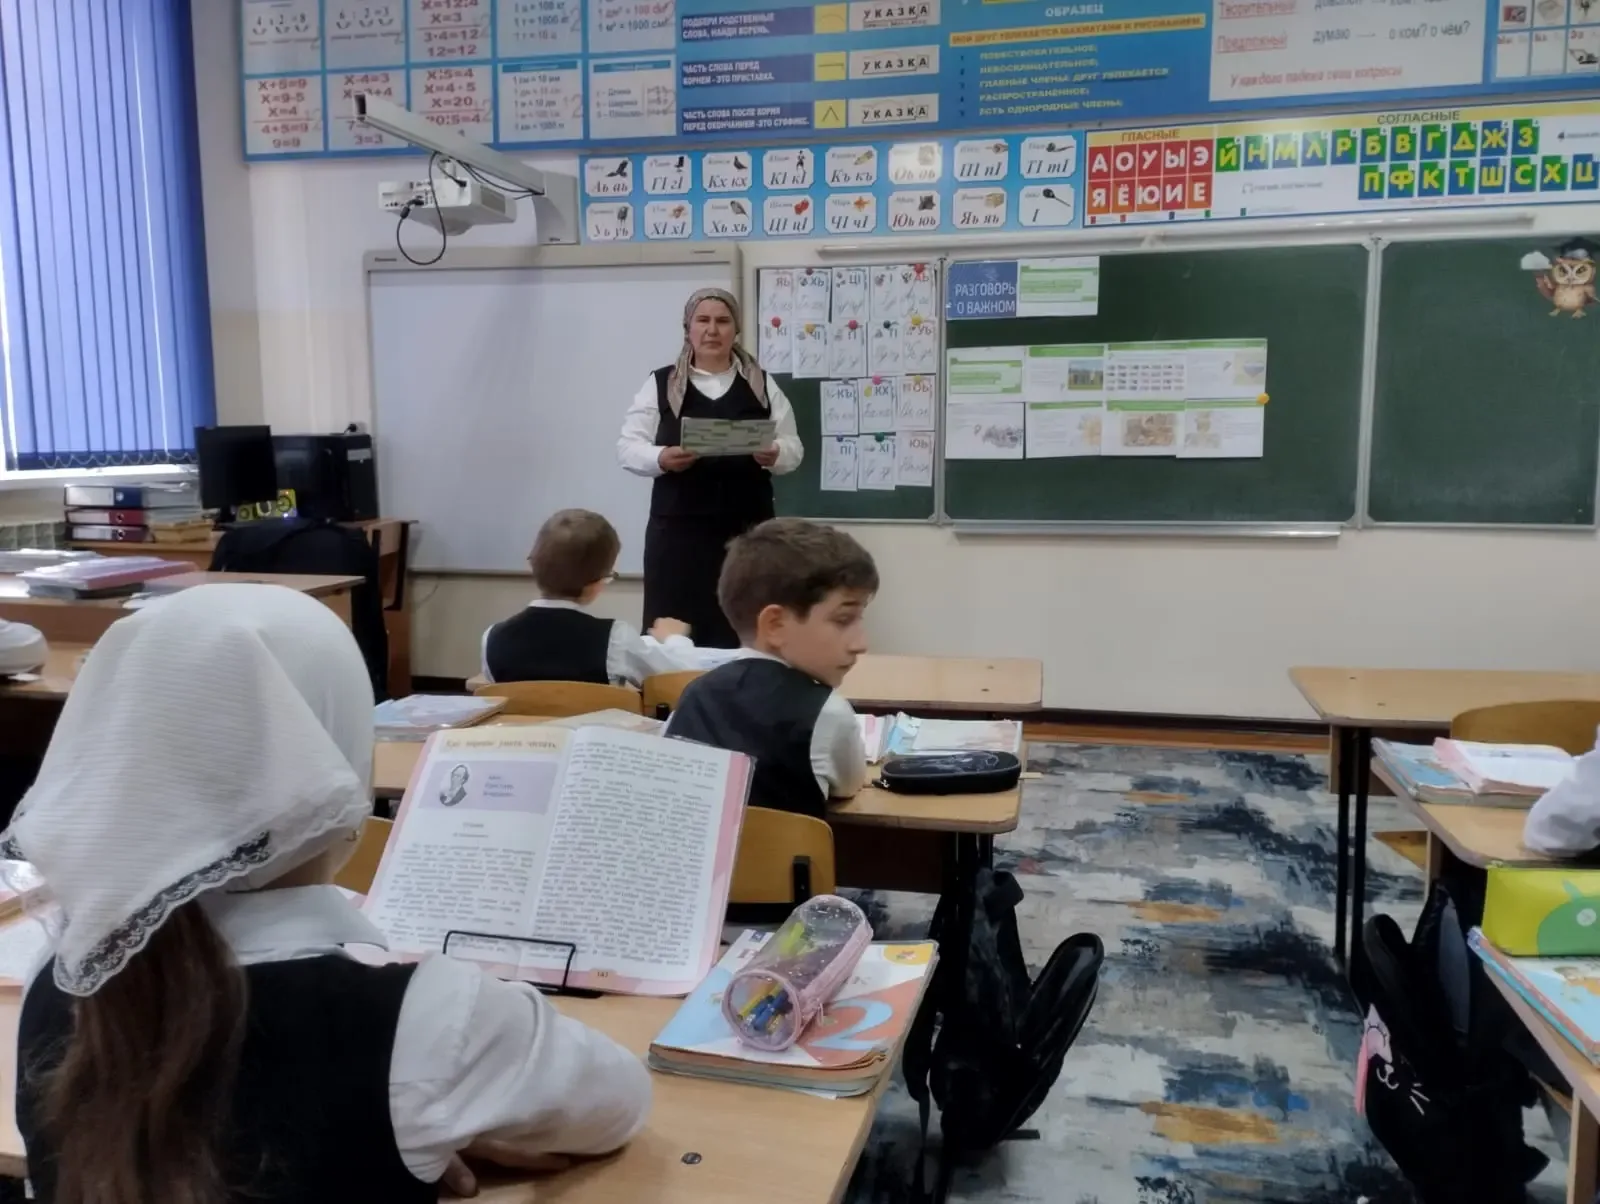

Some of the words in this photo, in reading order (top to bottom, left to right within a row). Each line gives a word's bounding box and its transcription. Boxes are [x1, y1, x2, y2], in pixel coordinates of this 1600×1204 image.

[863, 5, 928, 19] УКАЗКА
[1045, 4, 1104, 17] ОБРАЗЕЦ
[1313, 28, 1351, 45] думаю
[1398, 22, 1428, 39] ком?
[863, 57, 927, 71] УКАЗКА
[863, 106, 926, 119] УКАЗКА
[1377, 110, 1460, 125] СОГЛАСНЫЕ
[1121, 128, 1180, 143] ГЛАСНЫЕ
[1092, 154, 1108, 173] А
[1115, 151, 1134, 171] О
[1142, 149, 1157, 170] У
[1165, 148, 1185, 169] Ы
[1192, 146, 1209, 166] Э
[1363, 172, 1379, 193] П
[1389, 170, 1415, 191] Ф
[1422, 169, 1440, 190] К
[1455, 167, 1469, 188] Т
[1481, 166, 1504, 187] Ш
[1514, 164, 1532, 185] С
[1543, 163, 1561, 184] Х
[1575, 161, 1595, 183] Ц
[1092, 187, 1107, 208] Я
[1118, 183, 1130, 206] Ё
[1136, 185, 1161, 206] Ю
[1165, 183, 1183, 204] И
[1193, 181, 1207, 202] Е
[957, 303, 965, 314] О
[967, 301, 1016, 314] ВАЖНОМ
[809, 1000, 894, 1050] 2
